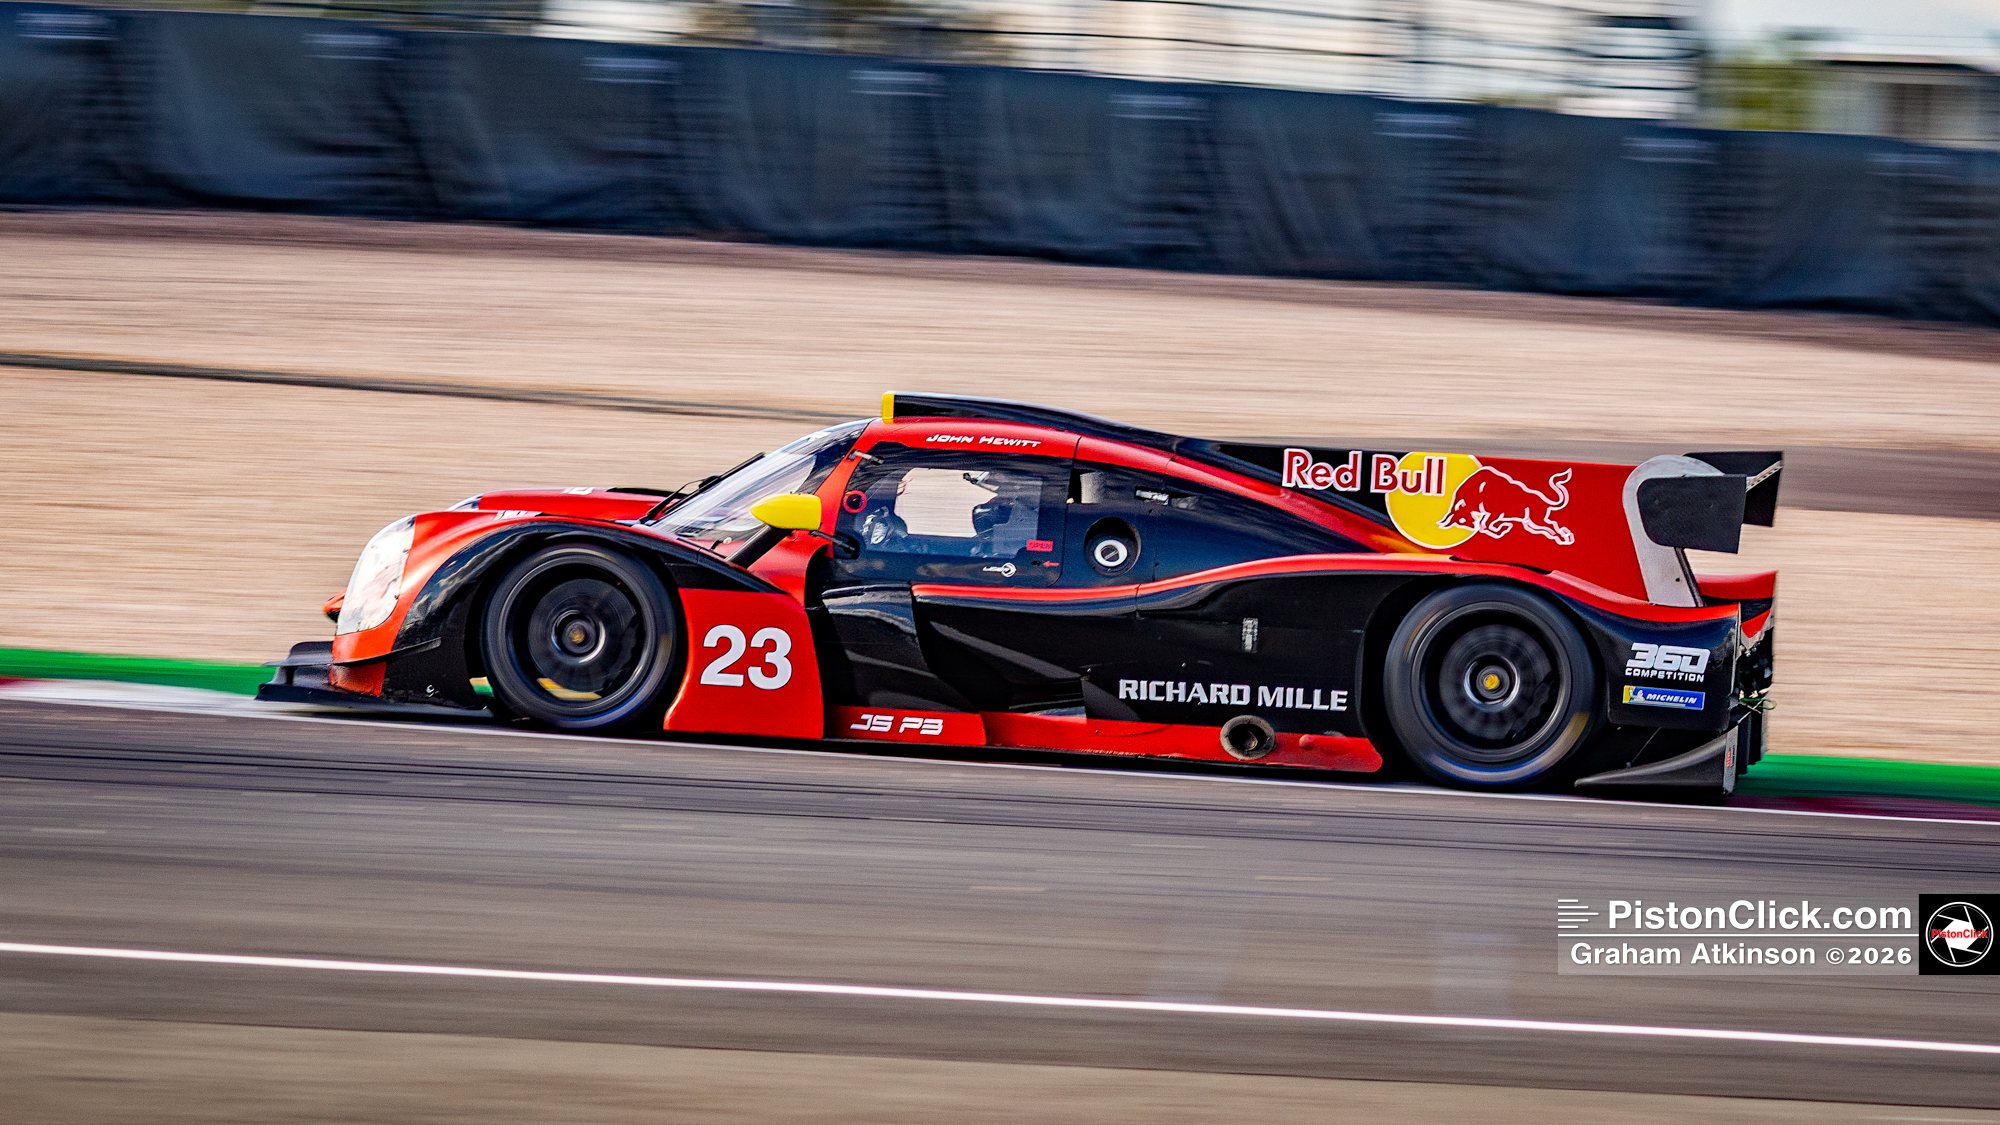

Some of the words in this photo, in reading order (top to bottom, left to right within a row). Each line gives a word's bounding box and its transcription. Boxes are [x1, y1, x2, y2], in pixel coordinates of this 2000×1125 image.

[926, 434, 974, 443] JOHN
[979, 436, 1042, 447] HEWITT
[1282, 448, 1362, 492] Red
[1370, 454, 1447, 497] Bull
[700, 624, 793, 691] 23
[1626, 642, 1711, 674] 360
[1625, 667, 1705, 683] COMPETITION
[1119, 678, 1252, 706] RICHARD
[1257, 685, 1348, 712] MILLE
[1646, 693, 1698, 704] MICHELIN
[850, 713, 893, 734] JS
[899, 716, 944, 736] P3
